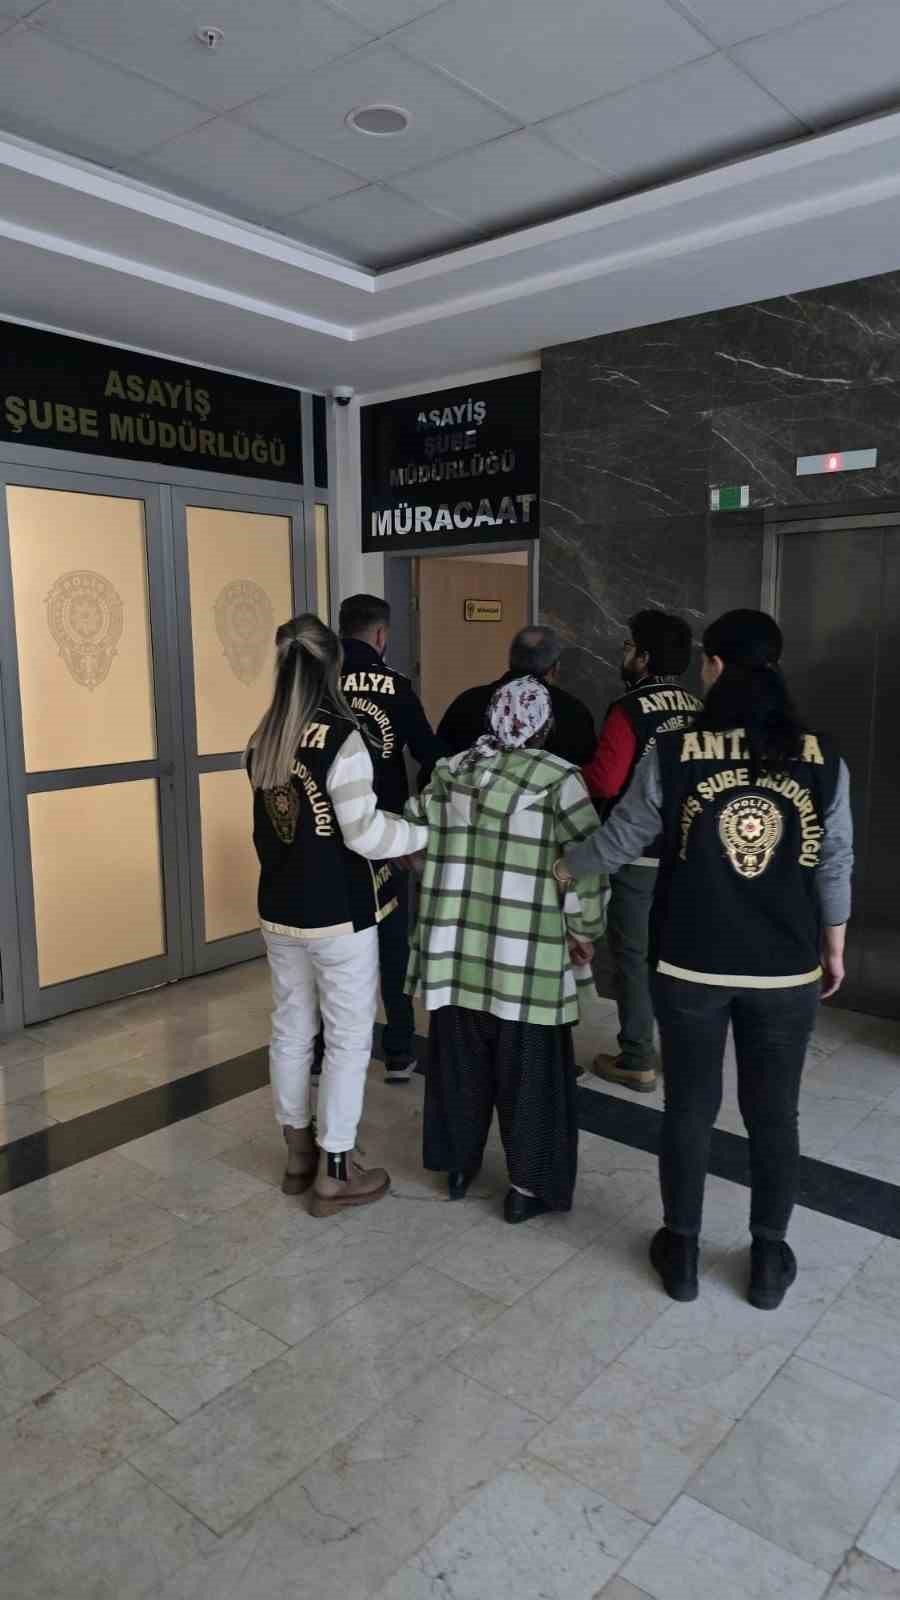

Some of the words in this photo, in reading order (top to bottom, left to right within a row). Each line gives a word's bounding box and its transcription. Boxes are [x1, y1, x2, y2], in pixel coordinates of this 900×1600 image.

[104, 369, 212, 421] ASAYİŞ
[417, 398, 487, 430] ASAYİŞ
[5, 396, 99, 438] ŞUBE
[109, 413, 287, 466] MÜDÜRLÜĞÜ
[424, 429, 478, 458] ŞUBE
[389, 448, 515, 487] MÜDÜRLÜĞÜ
[371, 493, 537, 537] MÜRACAAT
[680, 727, 825, 766] ANTA
[696, 767, 751, 803] ŞUBE
